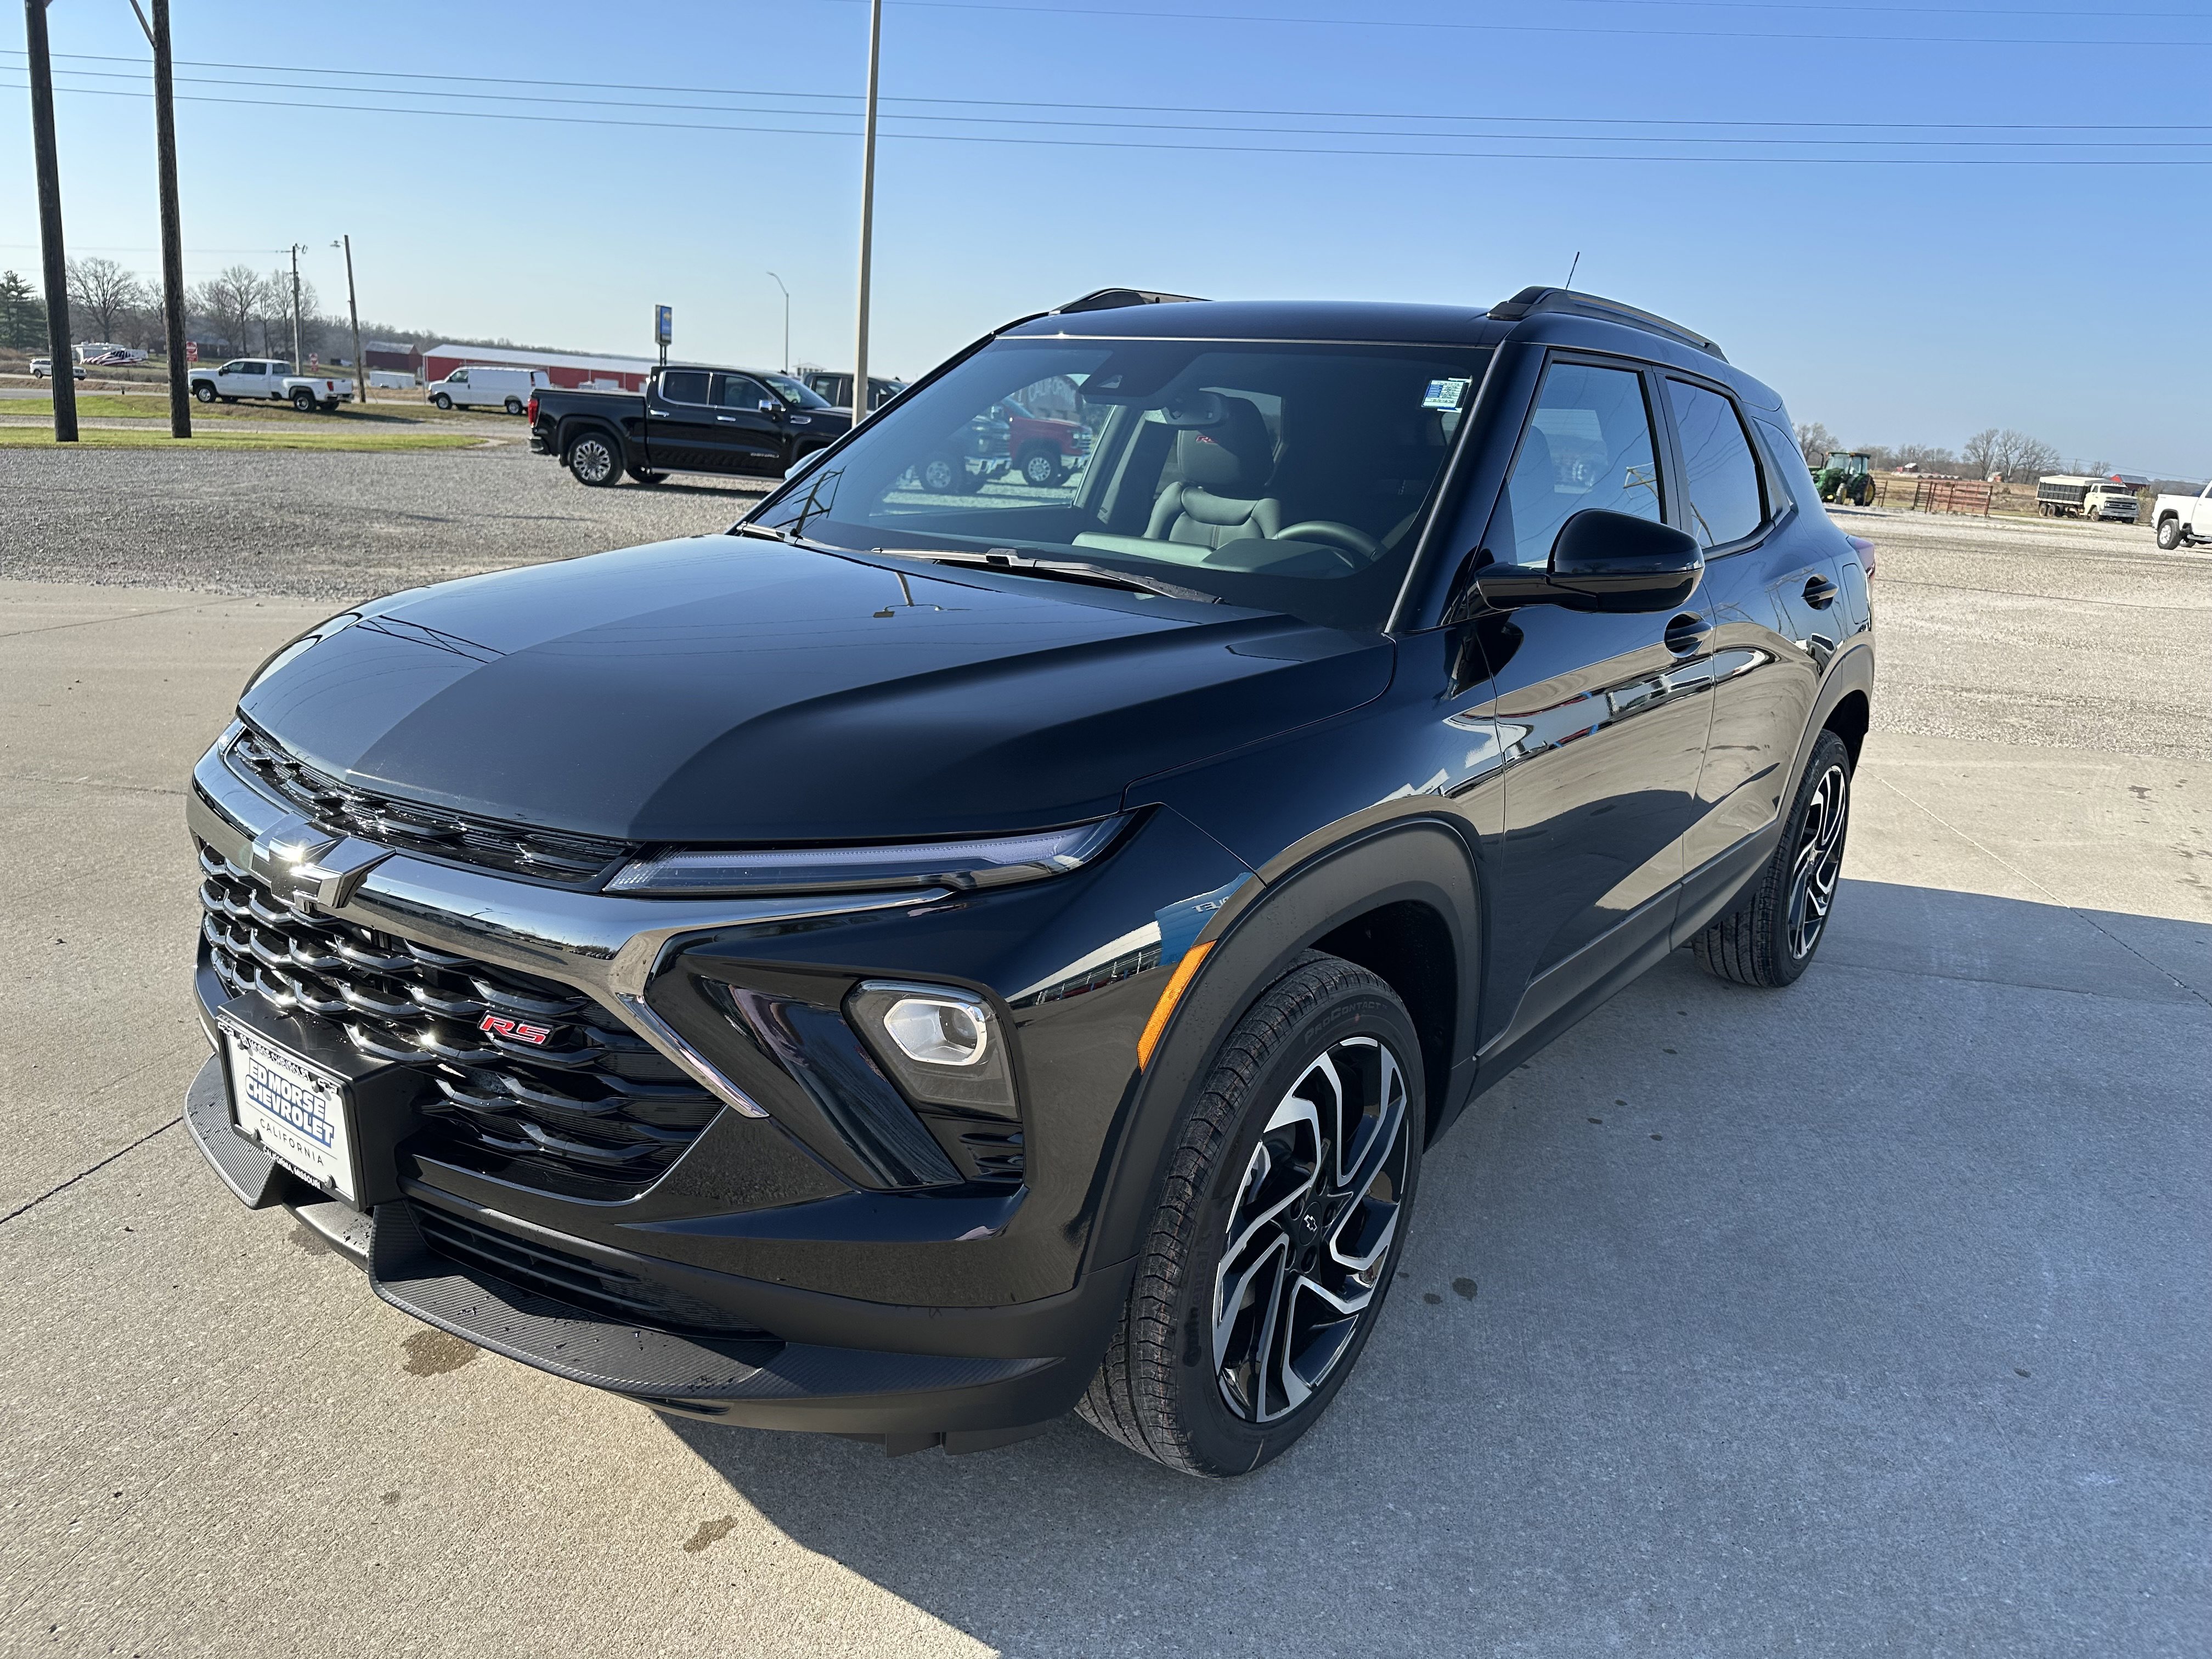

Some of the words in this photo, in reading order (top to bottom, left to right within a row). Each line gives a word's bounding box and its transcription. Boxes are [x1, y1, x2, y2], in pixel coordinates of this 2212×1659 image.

[479, 1014, 551, 1045] RS
[249, 1057, 268, 1086] ED
[268, 1069, 326, 1120] MORSE
[270, 1052, 311, 1081] CHEVROLET
[245, 1074, 335, 1148] CHEVROLET
[260, 1118, 324, 1166] CALIFORNIA
[263, 1145, 294, 1175] CALIFORNIA,
[294, 1167, 321, 1190] MISSOURI
